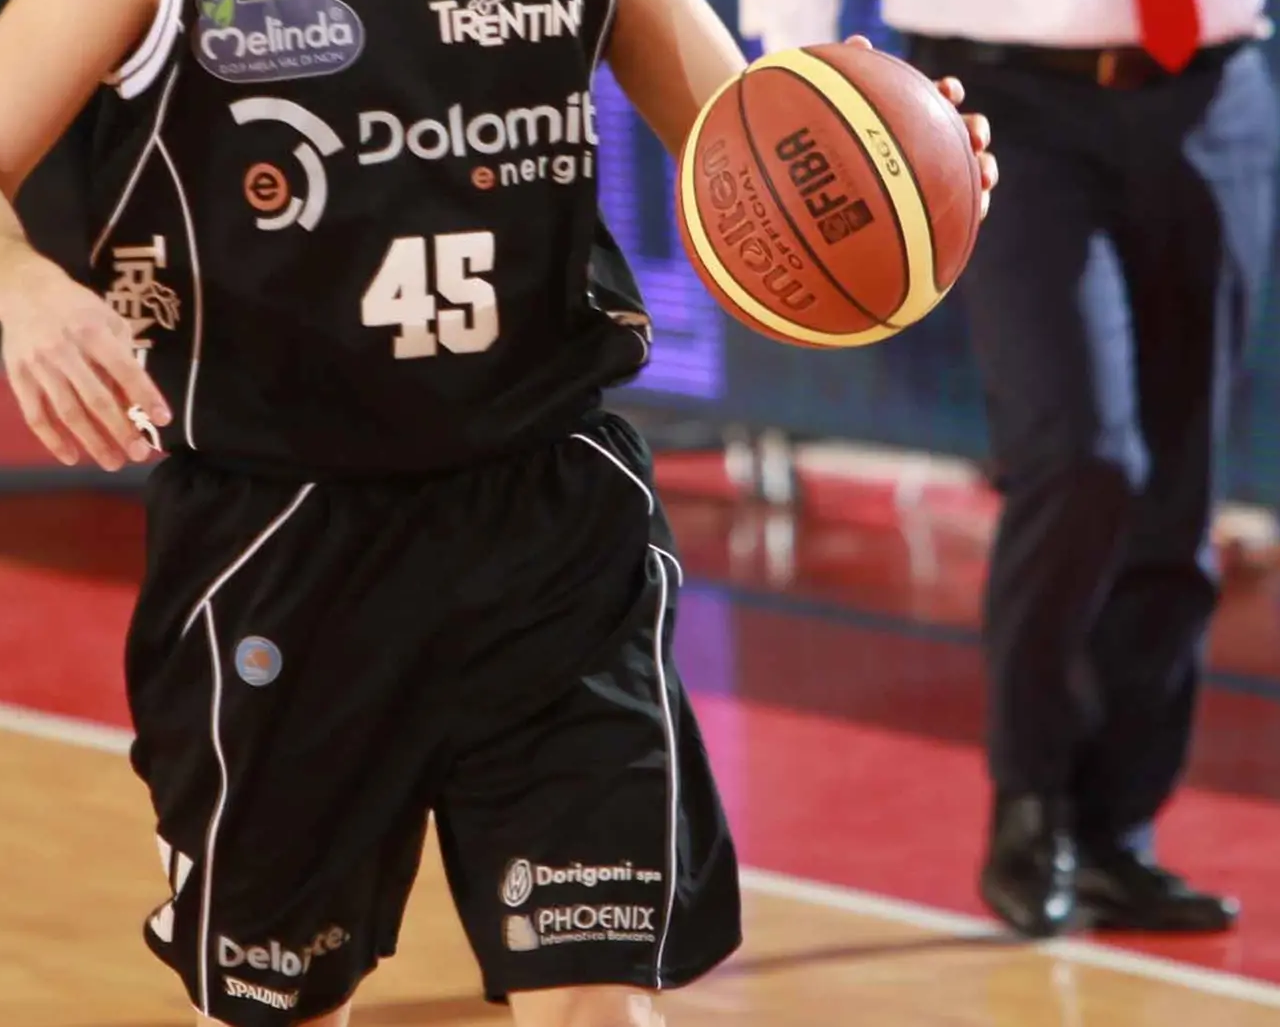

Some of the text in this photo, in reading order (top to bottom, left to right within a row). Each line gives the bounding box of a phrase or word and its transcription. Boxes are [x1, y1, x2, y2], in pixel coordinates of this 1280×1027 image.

[200, 10, 354, 60] Melinda
[737, 165, 805, 271] OFFICIAL
[776, 126, 849, 220] FIBA
[701, 138, 817, 313] molten
[361, 230, 500, 360] 45
[536, 861, 632, 887] Dorigoni
[636, 870, 662, 883] spa
[539, 906, 655, 933] PHOENIX
